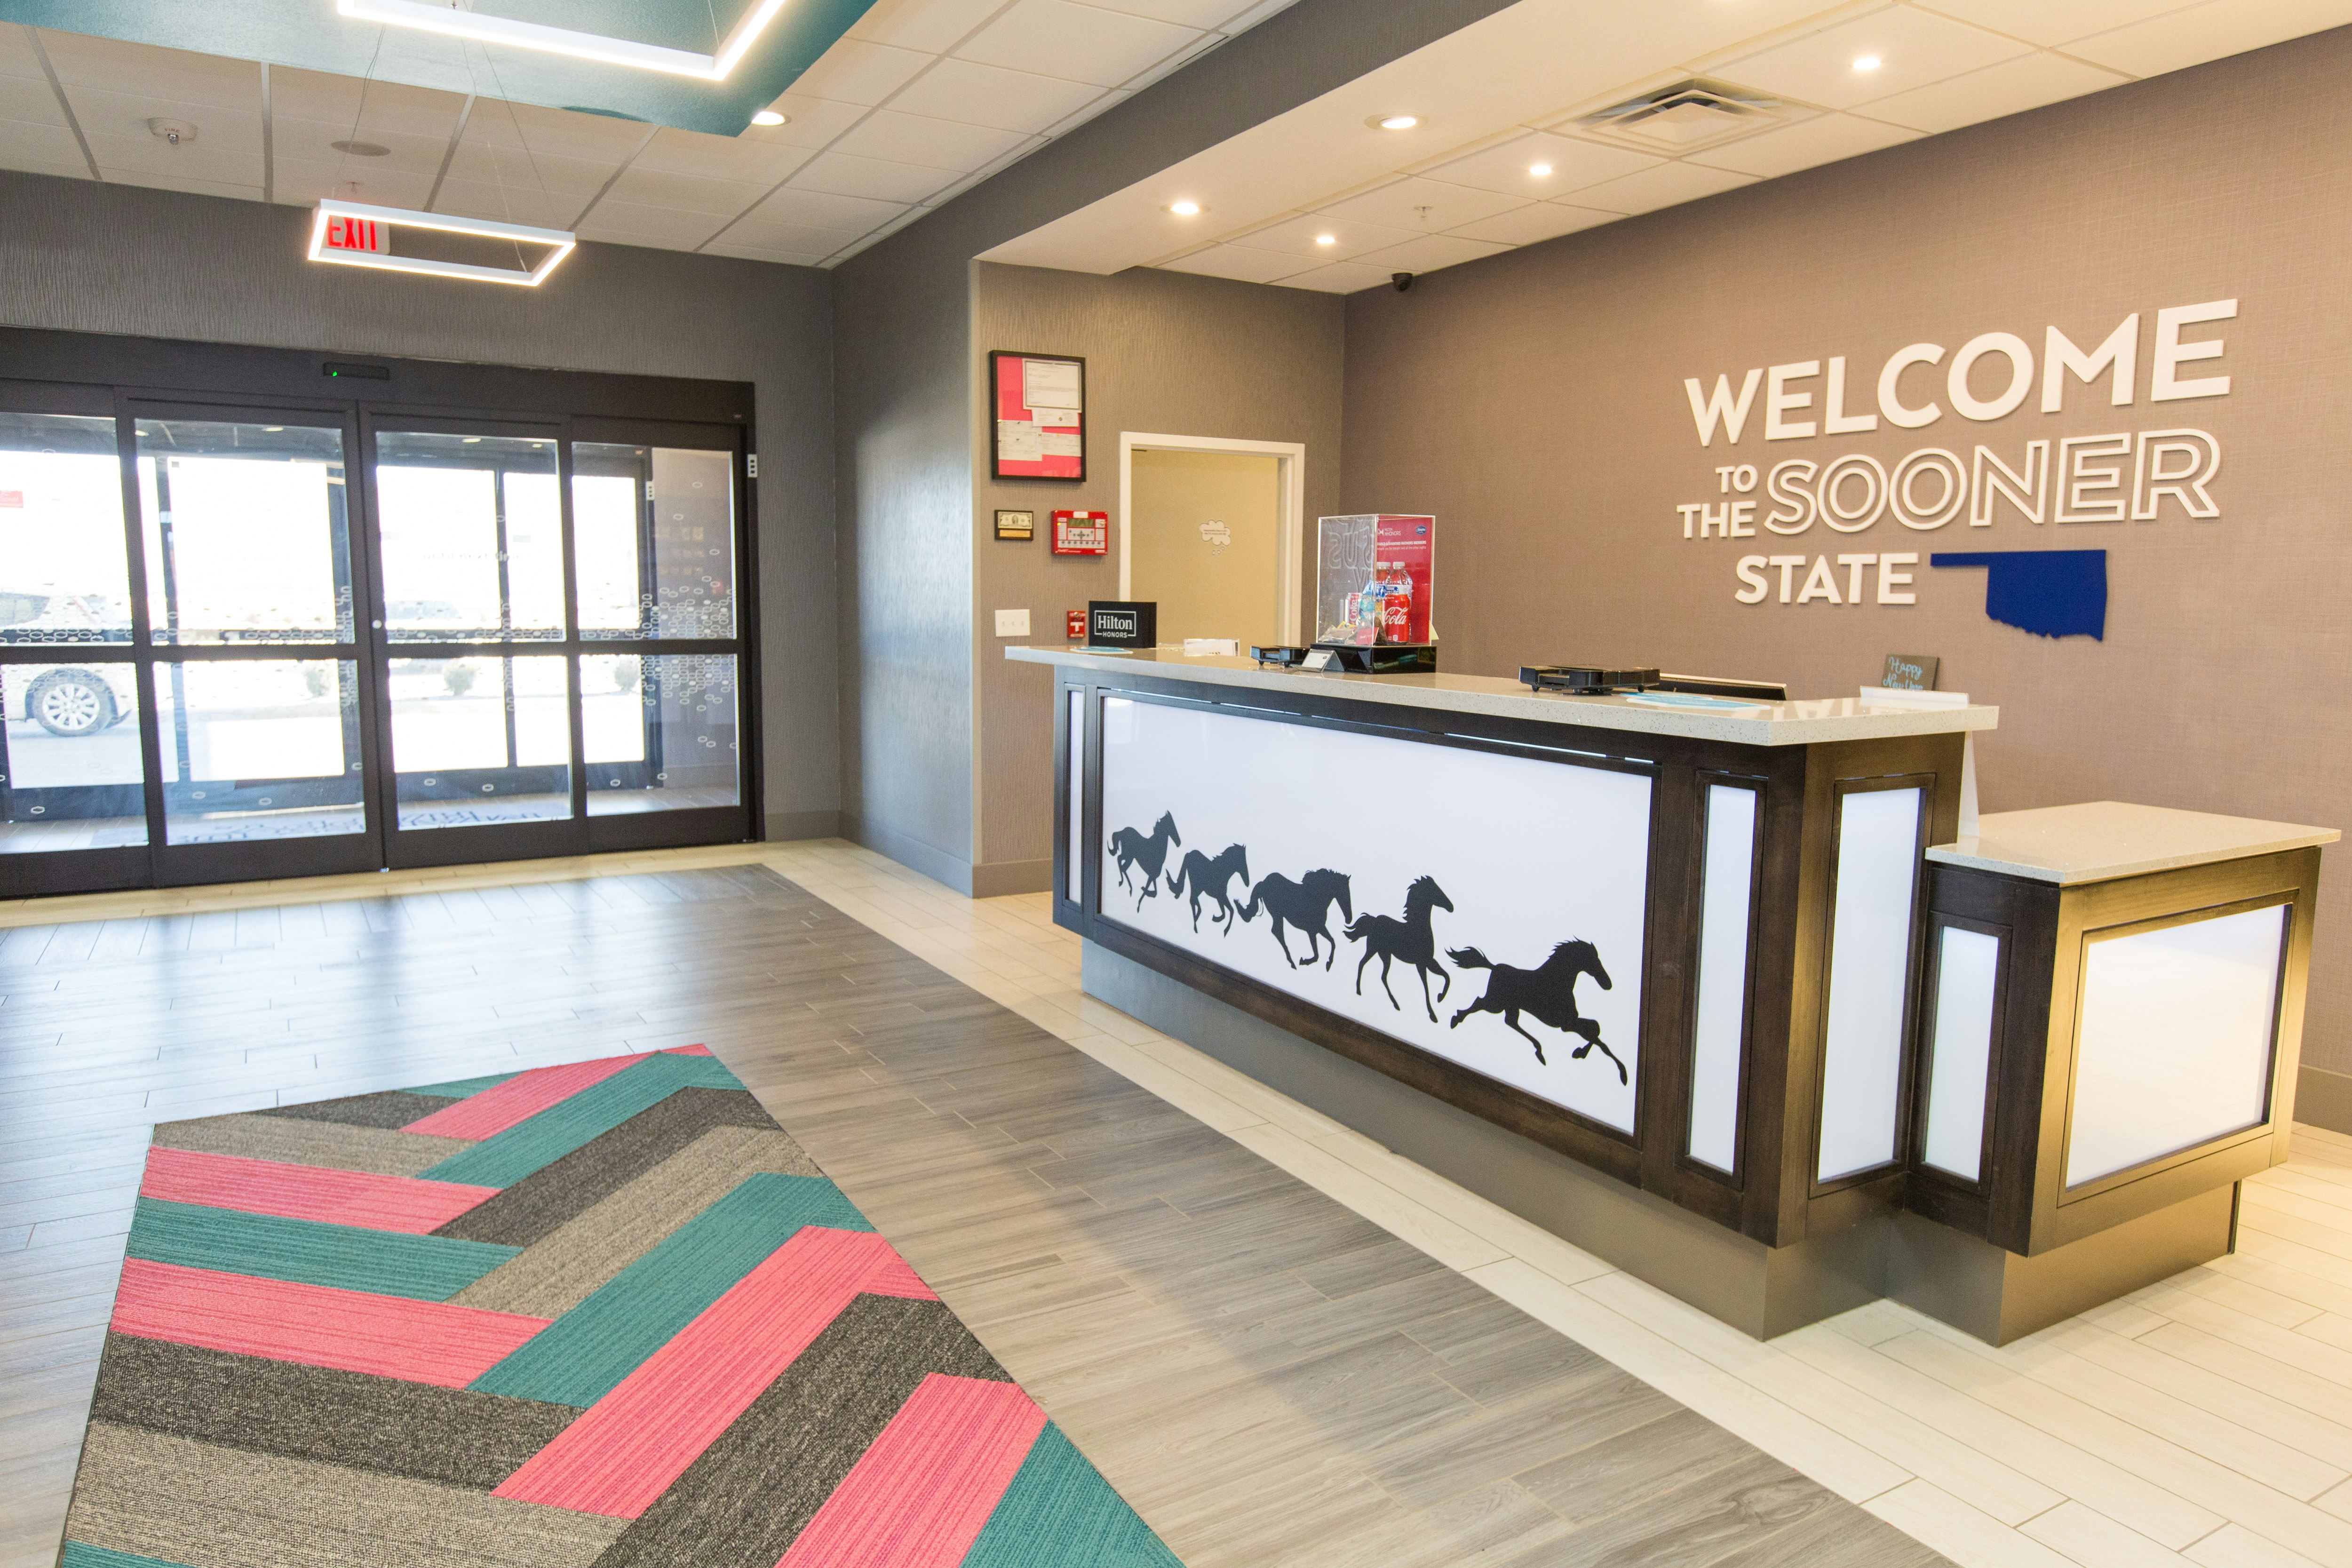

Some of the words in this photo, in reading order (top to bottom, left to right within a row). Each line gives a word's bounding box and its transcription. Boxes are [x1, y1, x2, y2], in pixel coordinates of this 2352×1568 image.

[1684, 299, 2238, 446] WELCOME
[1677, 501, 1756, 539] THE
[1764, 428, 2221, 535] SOONER
[1715, 464, 1758, 493] TO
[1734, 552, 1919, 605] STATE
[1097, 615, 1133, 630] Hilton
[1349, 599, 1358, 621] Coke
[1384, 606, 1409, 625] Cola
[1889, 656, 1923, 680] Happy
